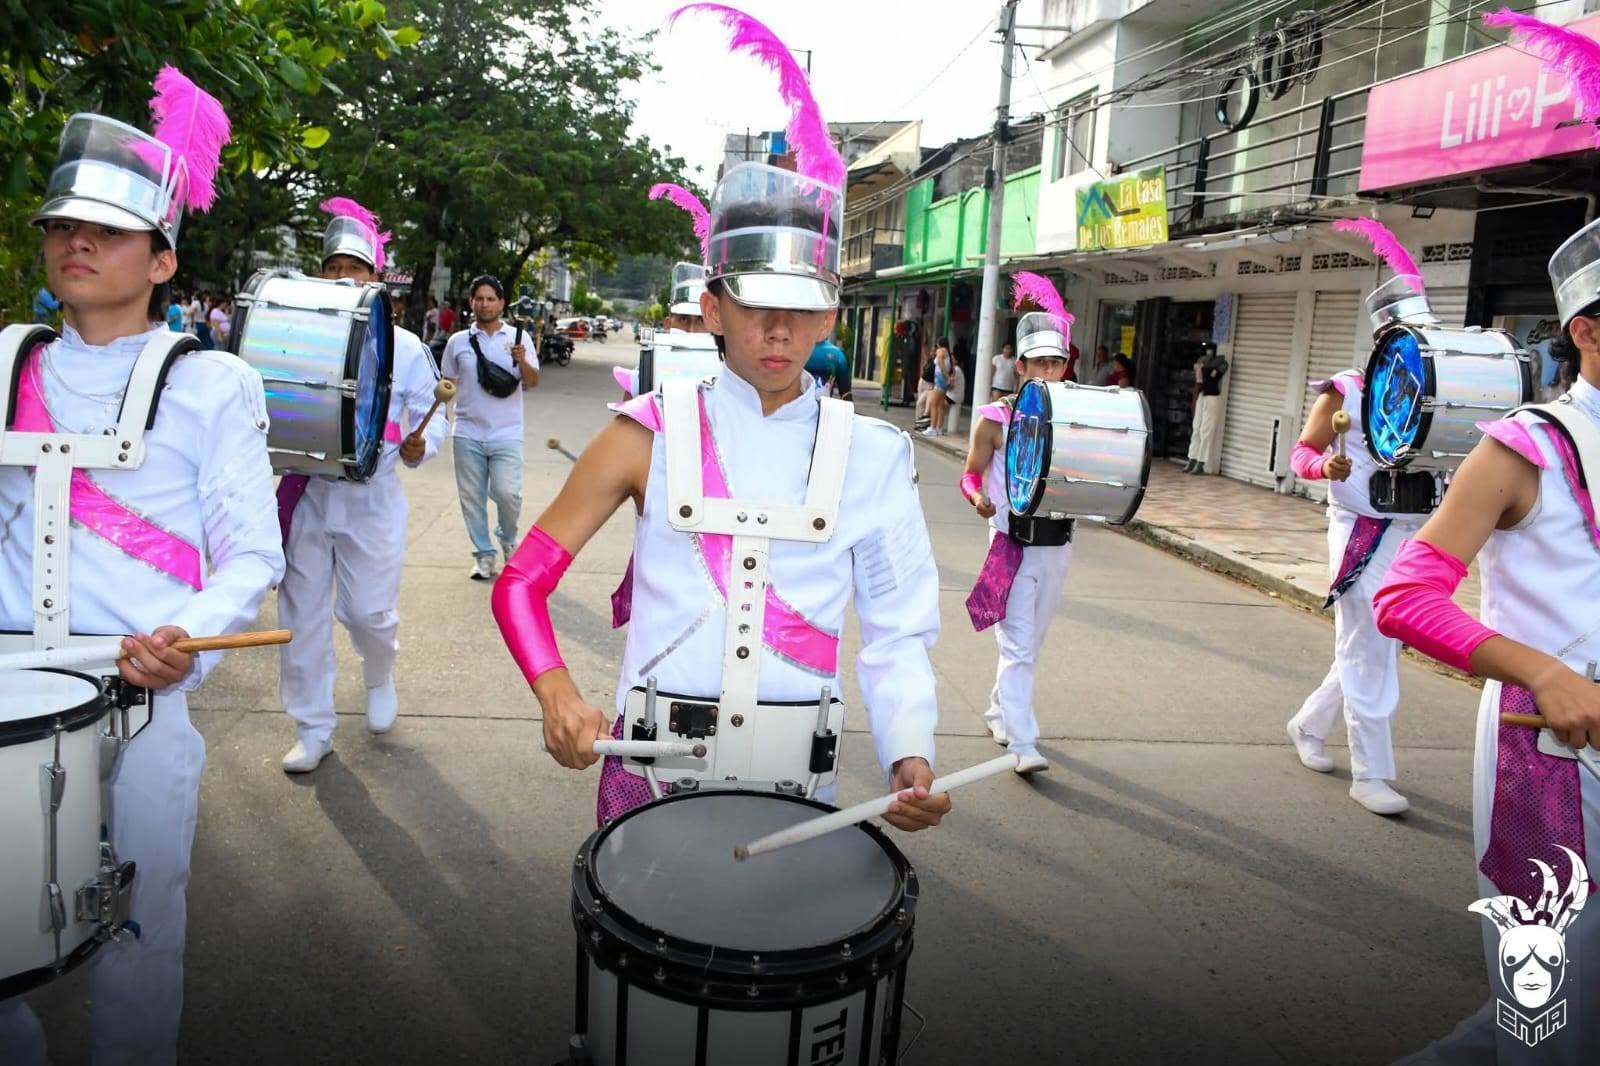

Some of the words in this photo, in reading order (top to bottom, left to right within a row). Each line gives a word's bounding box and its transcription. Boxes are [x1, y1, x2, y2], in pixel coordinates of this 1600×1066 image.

[1440, 74, 1506, 149] Lili
[1120, 183, 1133, 210] La
[1136, 177, 1162, 205] Casa
[1079, 224, 1093, 250] De
[1113, 215, 1163, 246] Remates
